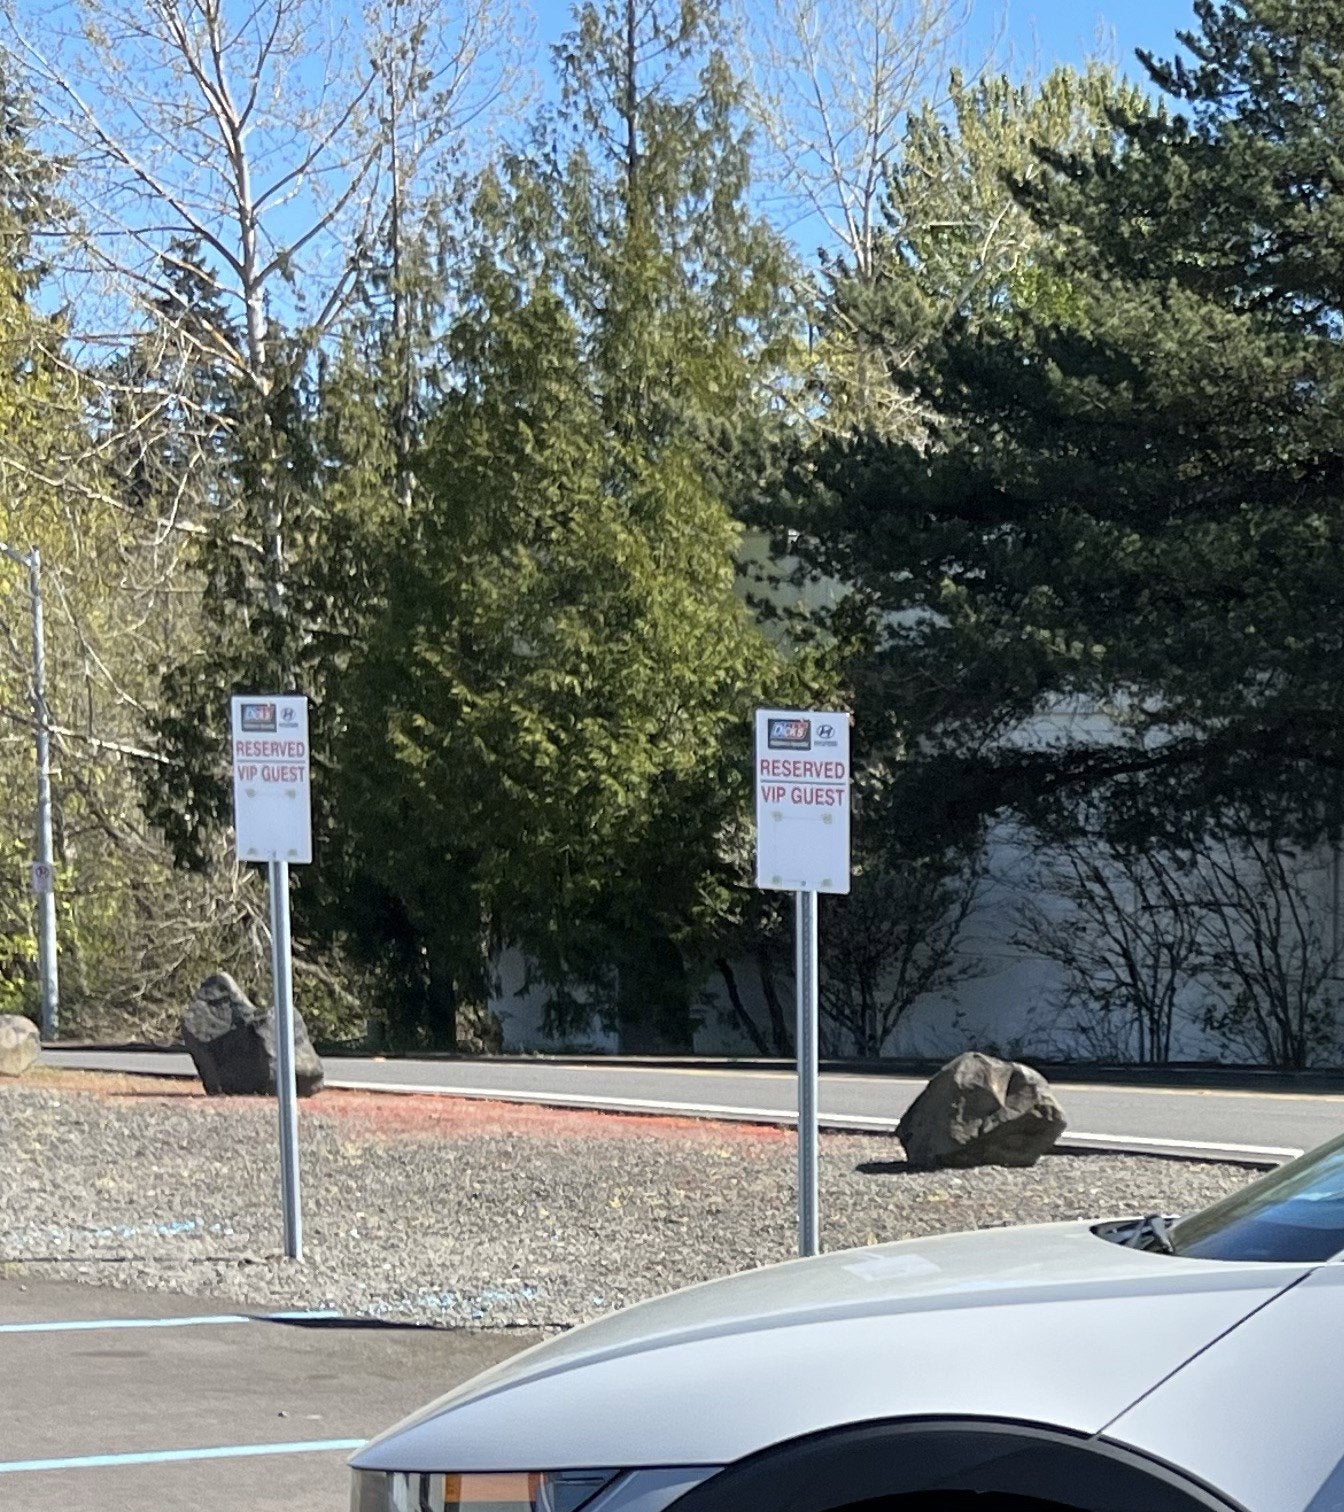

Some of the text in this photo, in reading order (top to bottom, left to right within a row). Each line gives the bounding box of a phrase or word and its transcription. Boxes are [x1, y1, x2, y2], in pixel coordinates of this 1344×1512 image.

[236, 740, 305, 758] RESERVED
[238, 766, 305, 782] VIP GUEST
[760, 759, 845, 779] RESERVED
[761, 785, 845, 806] VIP GUEST
